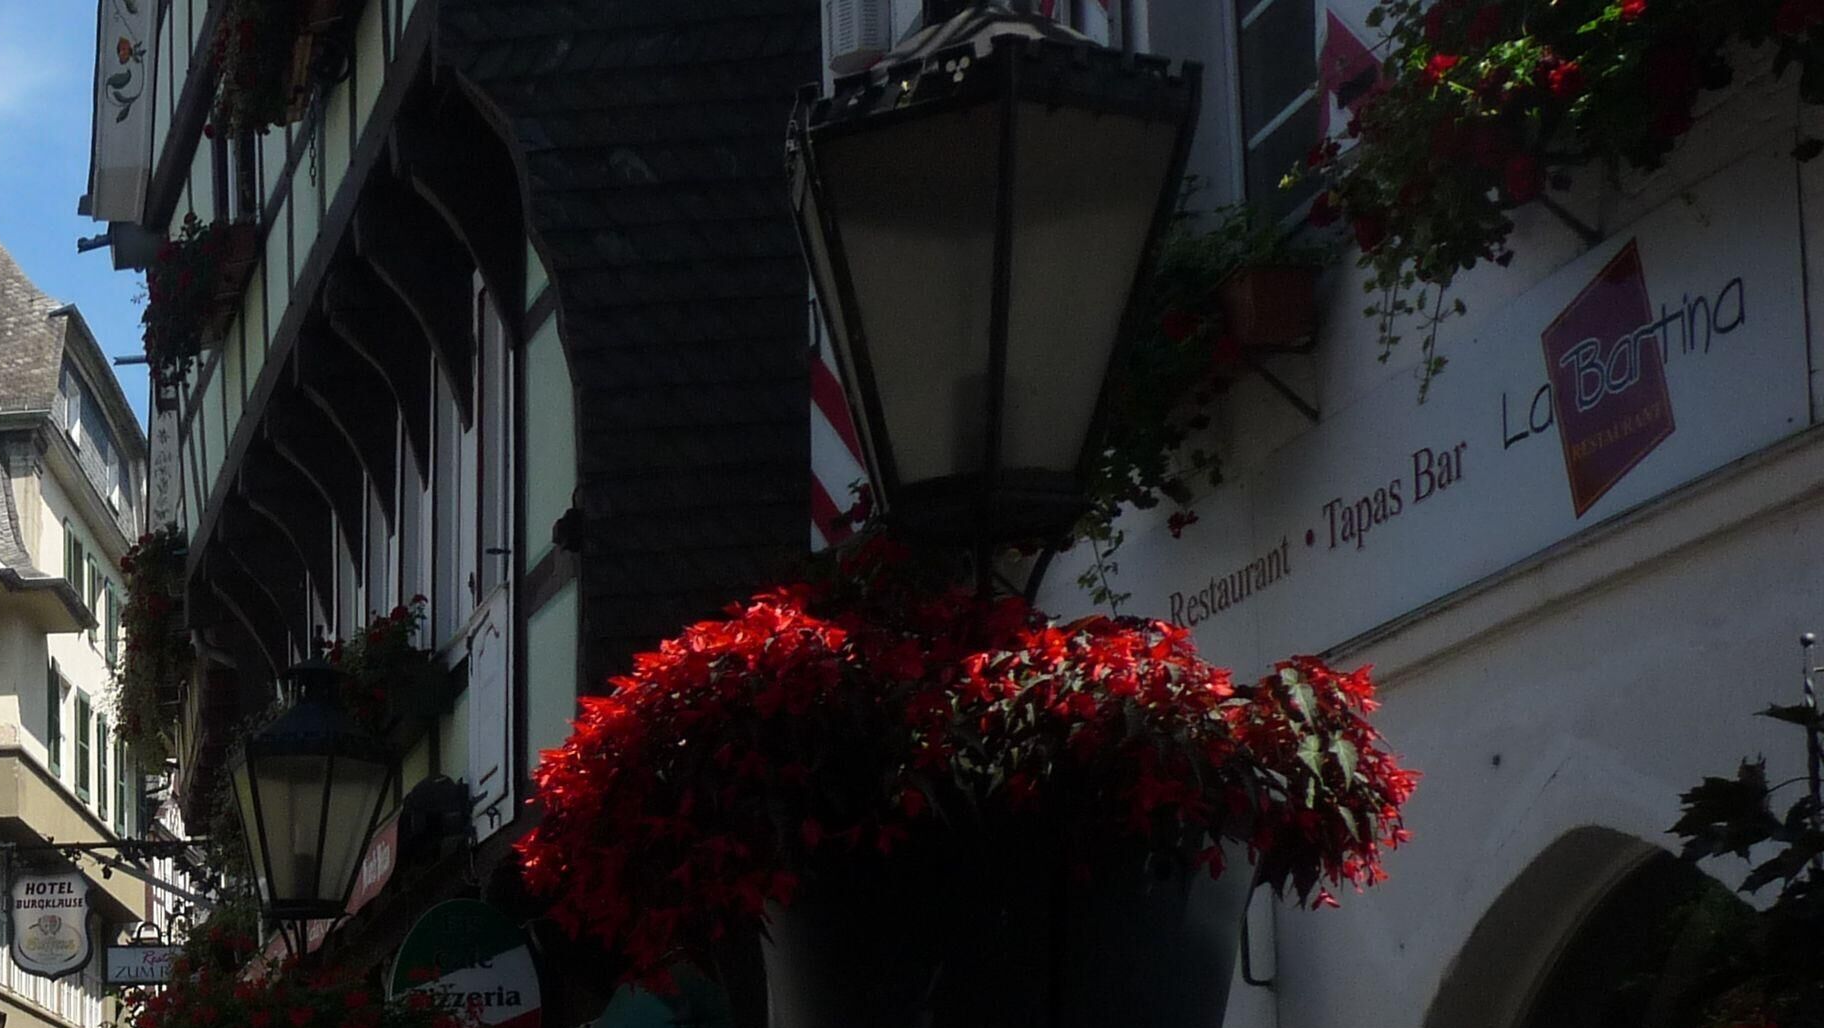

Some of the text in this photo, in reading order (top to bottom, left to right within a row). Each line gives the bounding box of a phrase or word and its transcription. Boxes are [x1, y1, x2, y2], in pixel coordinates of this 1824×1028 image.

[1502, 276, 1746, 450] La Bartina
[1169, 441, 1467, 629] Restaurant Tapas Bar
[25, 881, 74, 895] HOTEL
[16, 898, 83, 910] BURGKLAUSE
[115, 965, 155, 979] ZUM
